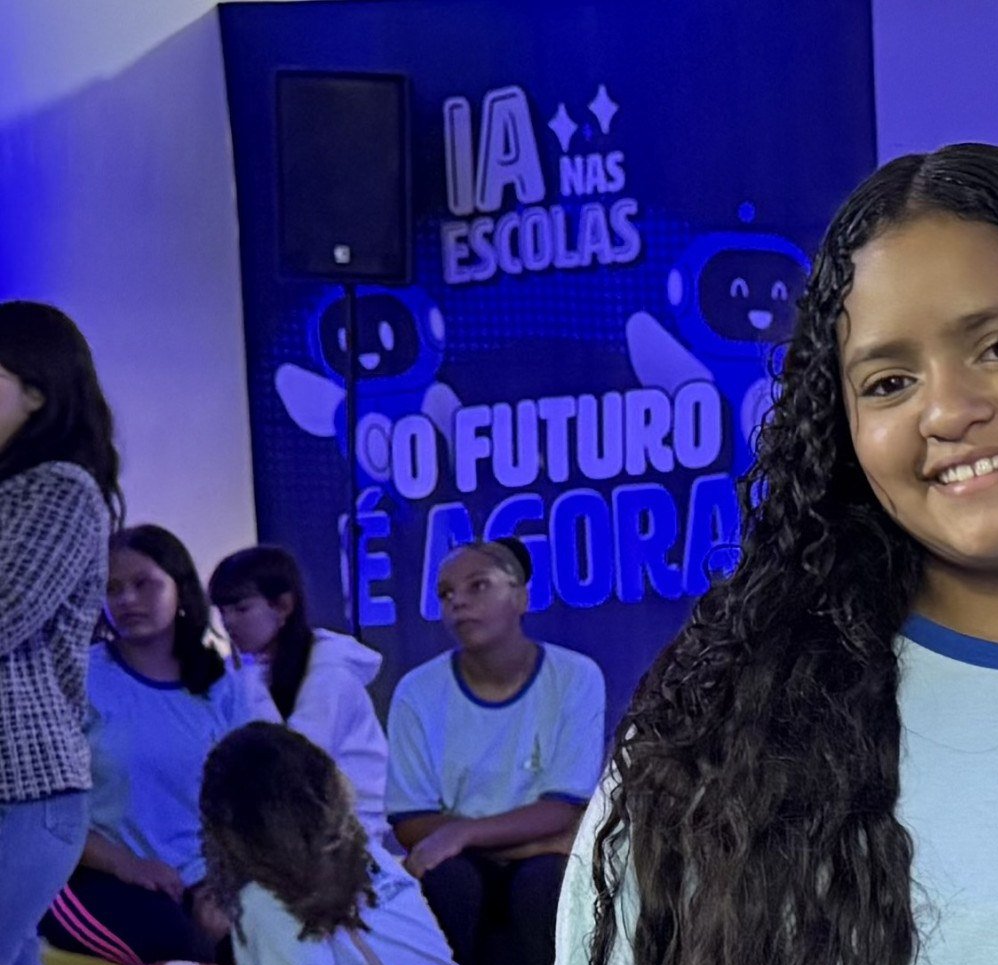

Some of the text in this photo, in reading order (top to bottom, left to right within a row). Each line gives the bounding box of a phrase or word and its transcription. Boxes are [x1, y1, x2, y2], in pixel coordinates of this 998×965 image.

[443, 85, 626, 215] IA NAS
[441, 199, 642, 285] ESCOLAS
[391, 381, 722, 499] O FUTURO
[337, 486, 397, 627] É
